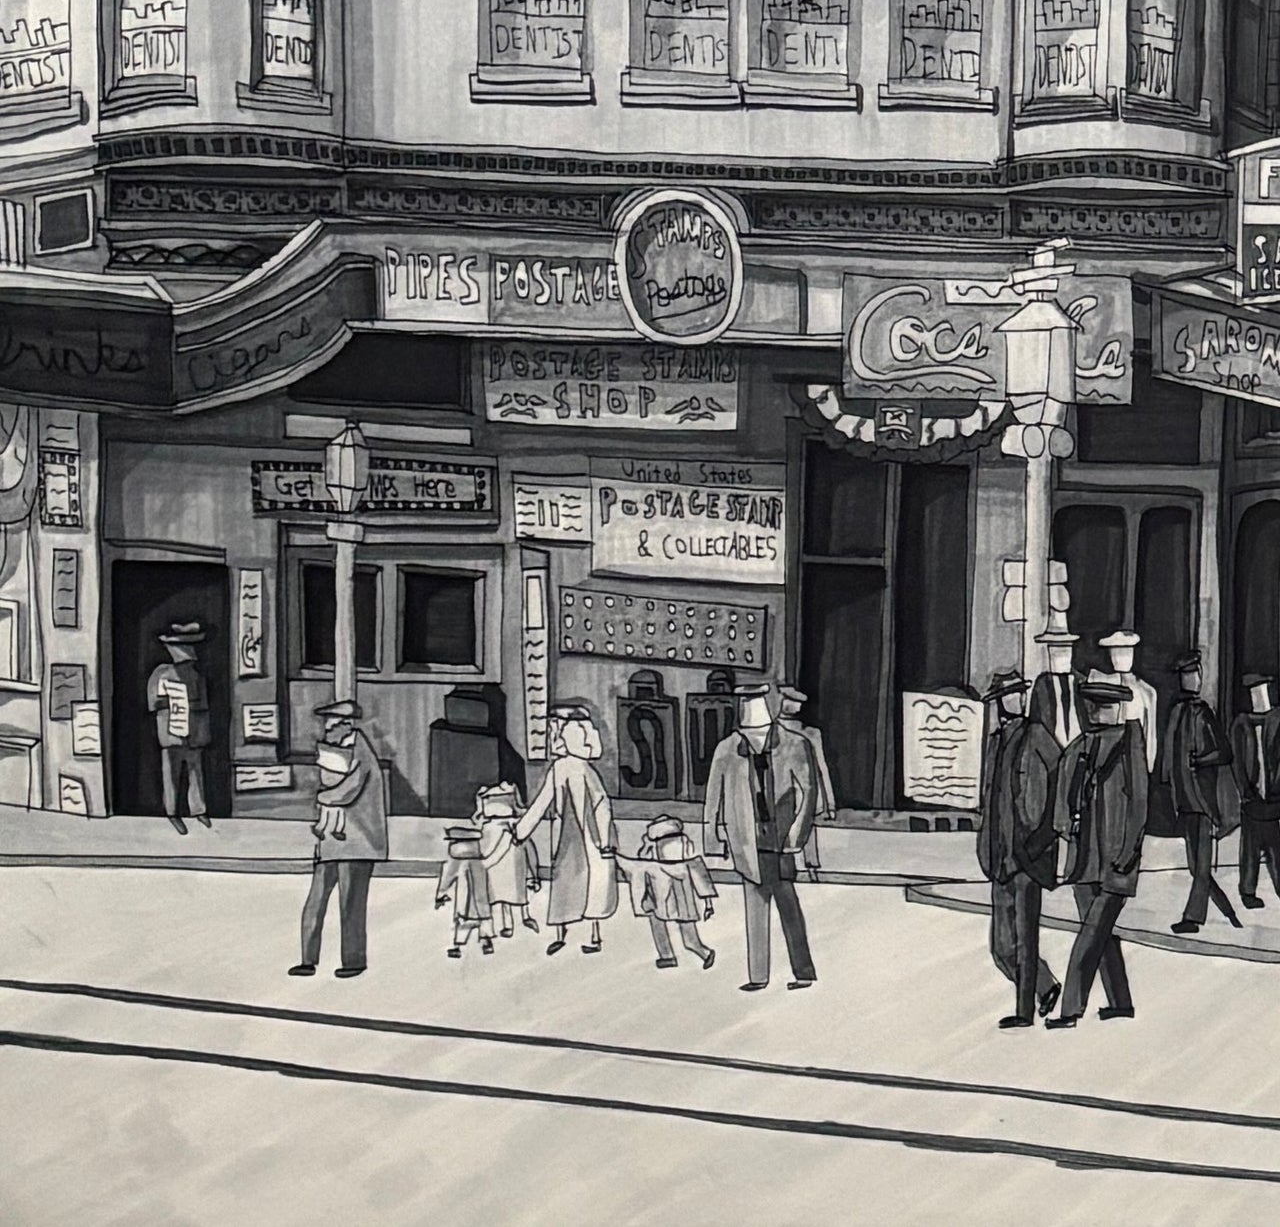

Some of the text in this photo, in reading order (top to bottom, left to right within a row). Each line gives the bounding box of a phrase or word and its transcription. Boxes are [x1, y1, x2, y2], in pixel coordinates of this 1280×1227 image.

[384, 247, 621, 307] PIPES POSTAGE
[849, 285, 996, 384] Coca
[489, 347, 738, 383] POSTAGE STAMPS
[553, 380, 657, 420] SHOP
[275, 475, 314, 498] Get
[414, 474, 457, 499] Here
[621, 460, 752, 485] United States
[637, 530, 778, 561] & COLLECTABLES
